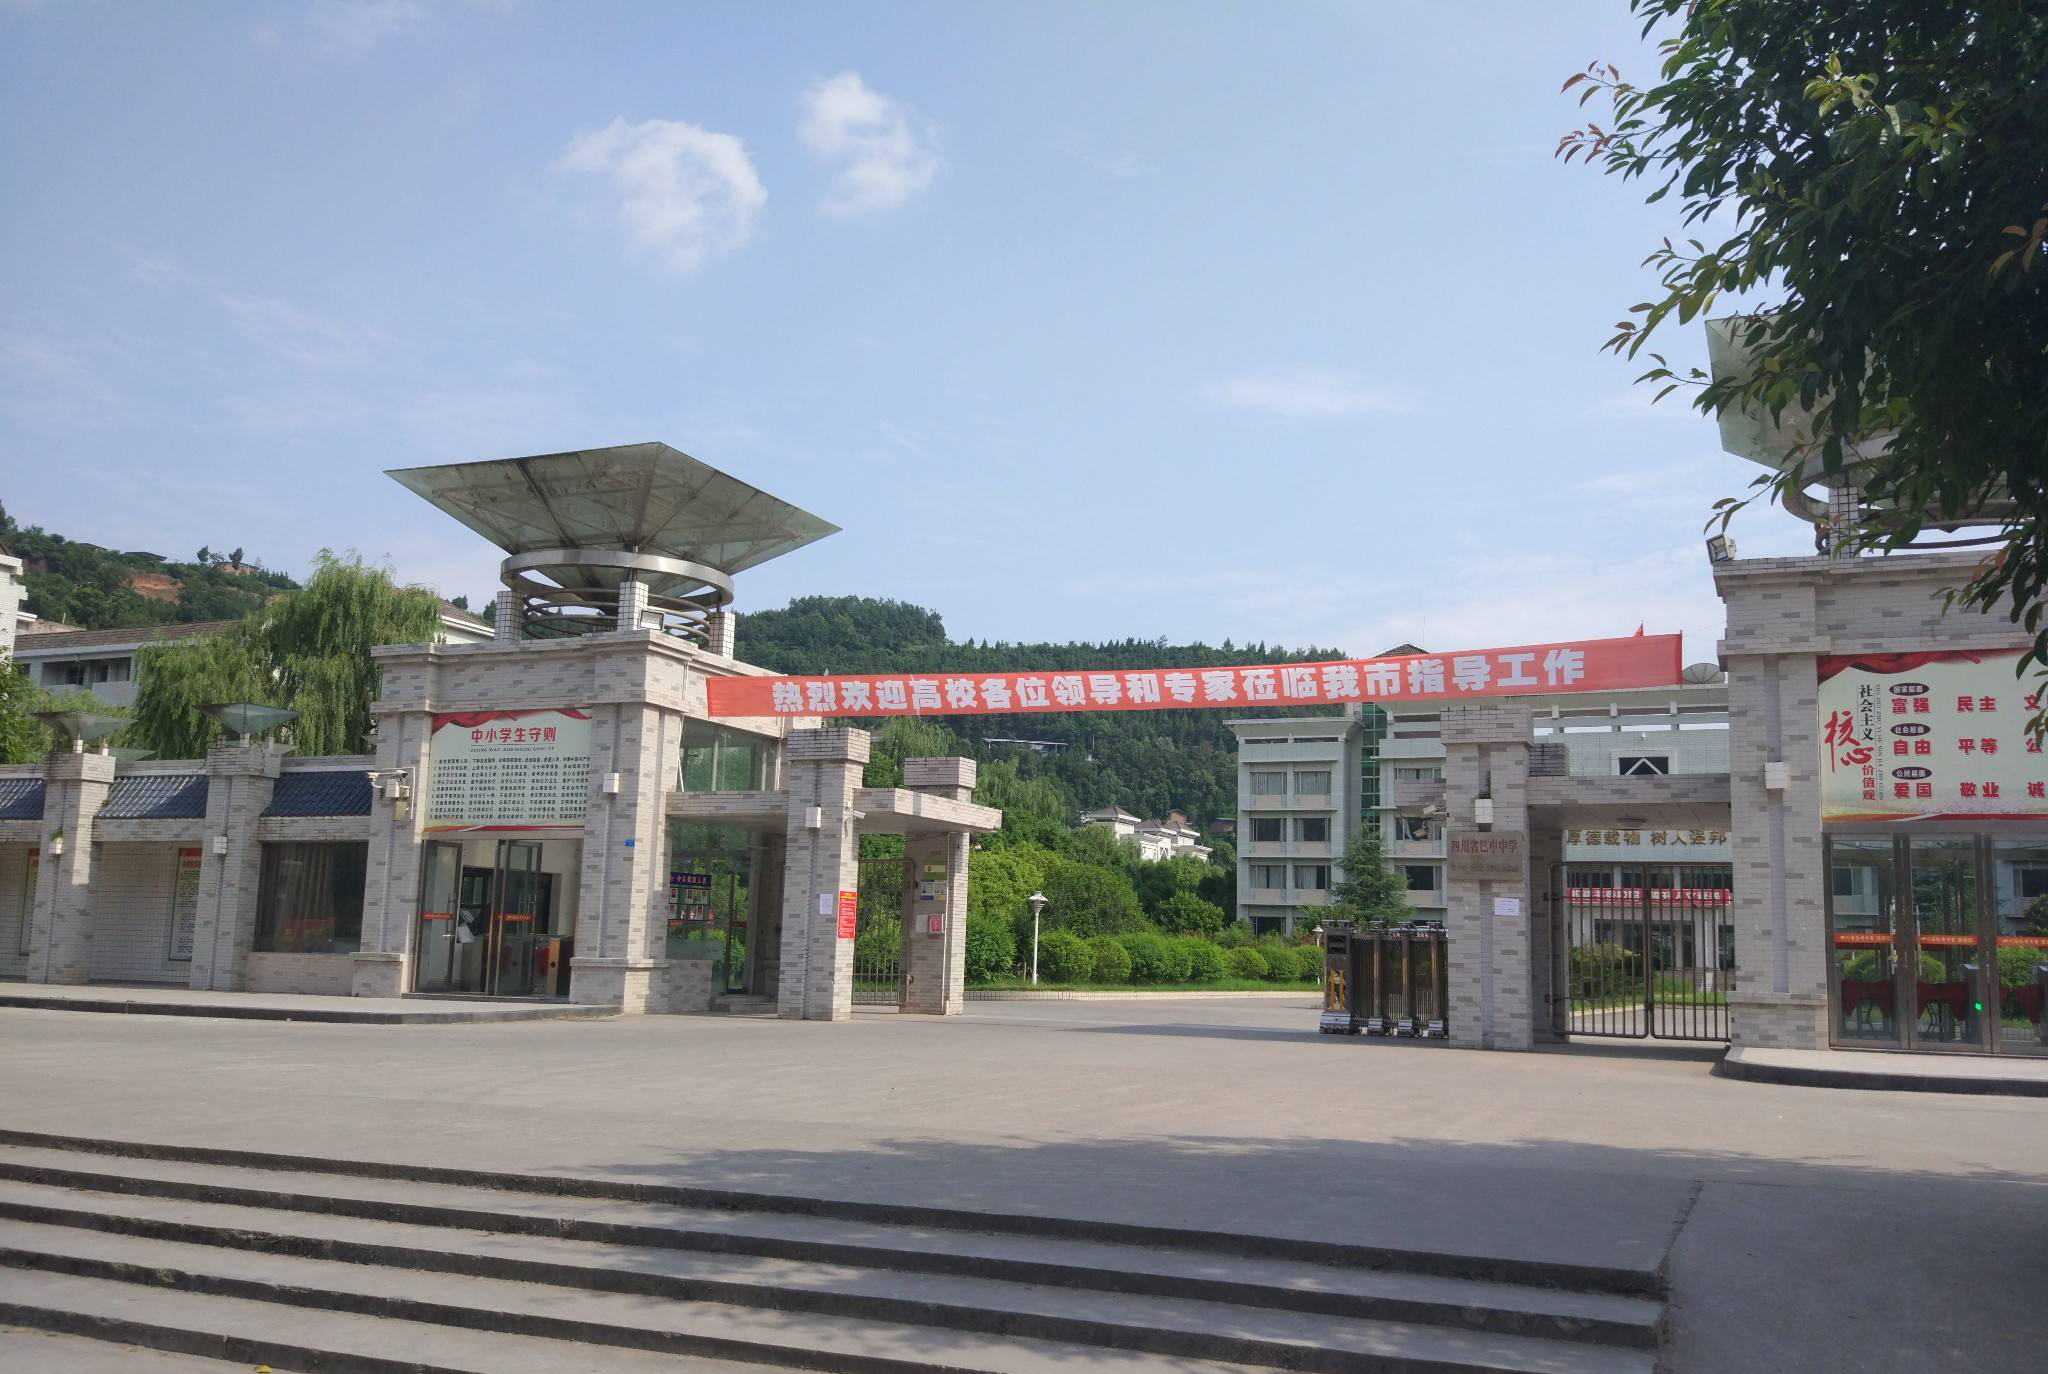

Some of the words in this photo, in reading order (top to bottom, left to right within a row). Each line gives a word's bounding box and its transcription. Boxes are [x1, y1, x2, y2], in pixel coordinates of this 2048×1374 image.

[772, 649, 1585, 713] 热烈欢迎高校各位领导和专家莅临我市指导工作
[1860, 684, 1874, 741] 社会主义
[1891, 698, 1930, 714] 富强
[1957, 696, 1997, 712] 民主
[472, 727, 556, 743] 中小学生守则
[1824, 710, 1873, 773] 核心
[1893, 739, 1932, 756] 自由
[1959, 738, 1999, 754] 平等
[1863, 765, 1875, 801] 价值观
[1894, 782, 1932, 799] 爱国
[1960, 782, 2000, 798] 敬业
[1451, 838, 1519, 854] 四川省巴中中学
[1567, 829, 1641, 846] 厚德载物
[1650, 829, 1727, 846] 树人强邦
